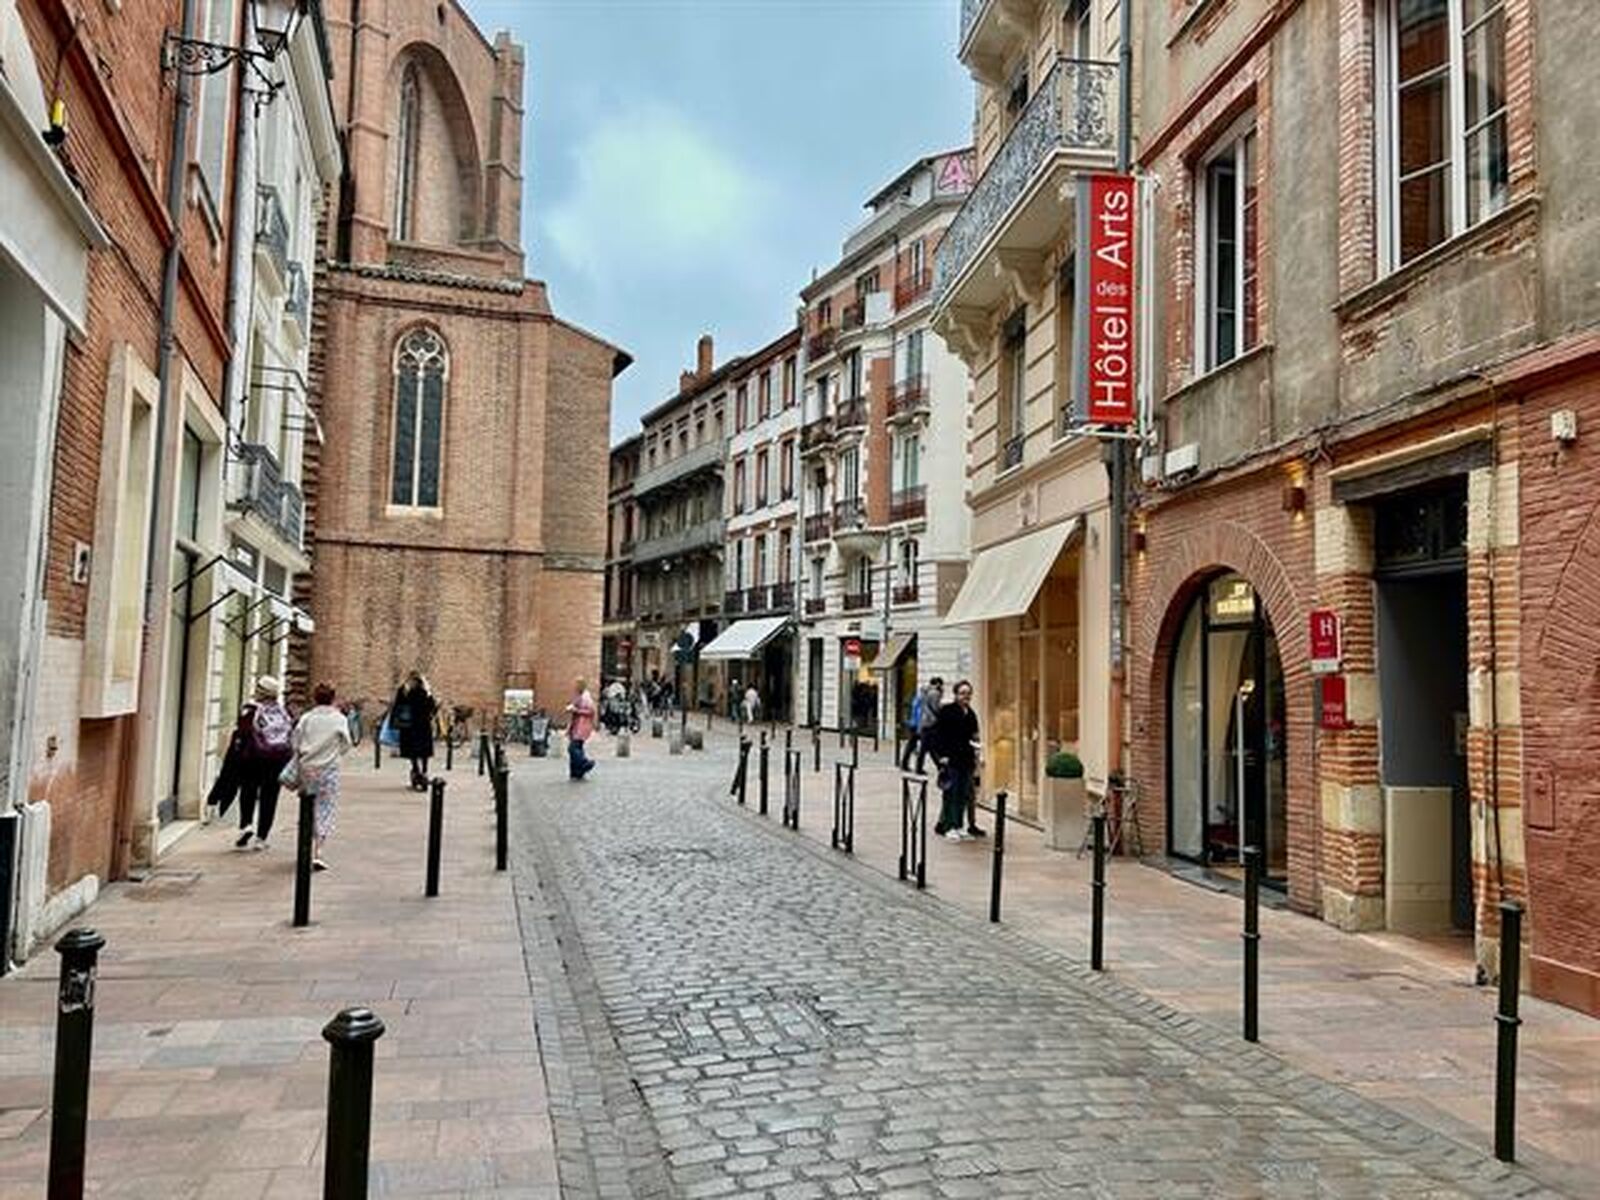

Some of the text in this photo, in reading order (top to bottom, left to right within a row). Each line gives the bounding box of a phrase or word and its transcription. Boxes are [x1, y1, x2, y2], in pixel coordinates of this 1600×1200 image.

[1094, 191, 1129, 408] Hôtel des Arts
[1320, 618, 1333, 636] H
